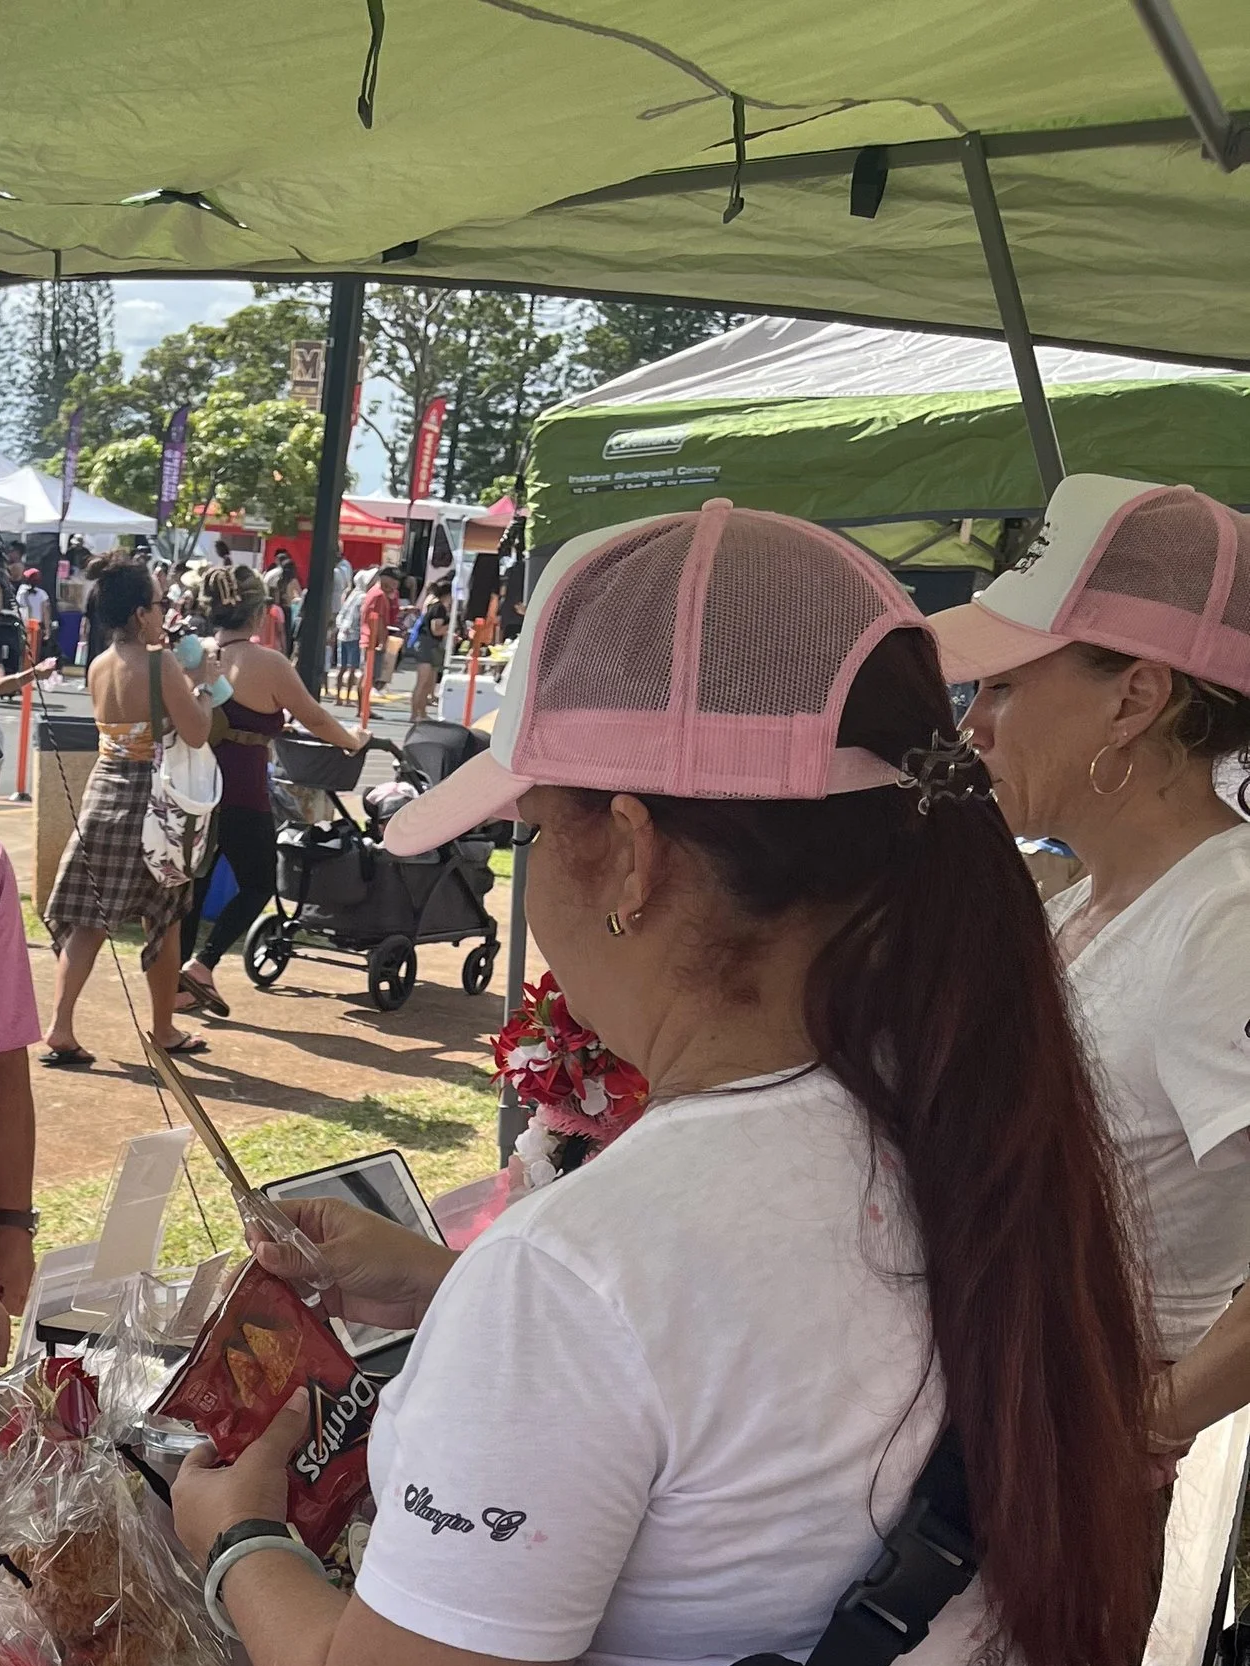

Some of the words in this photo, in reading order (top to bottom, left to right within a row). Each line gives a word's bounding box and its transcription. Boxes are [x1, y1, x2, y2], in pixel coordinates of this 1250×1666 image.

[568, 473, 611, 484] Instant
[677, 465, 721, 476] Canopy
[296, 1372, 377, 1483] Doritos
[404, 1484, 475, 1535] Slangin
[482, 1507, 527, 1541] G
